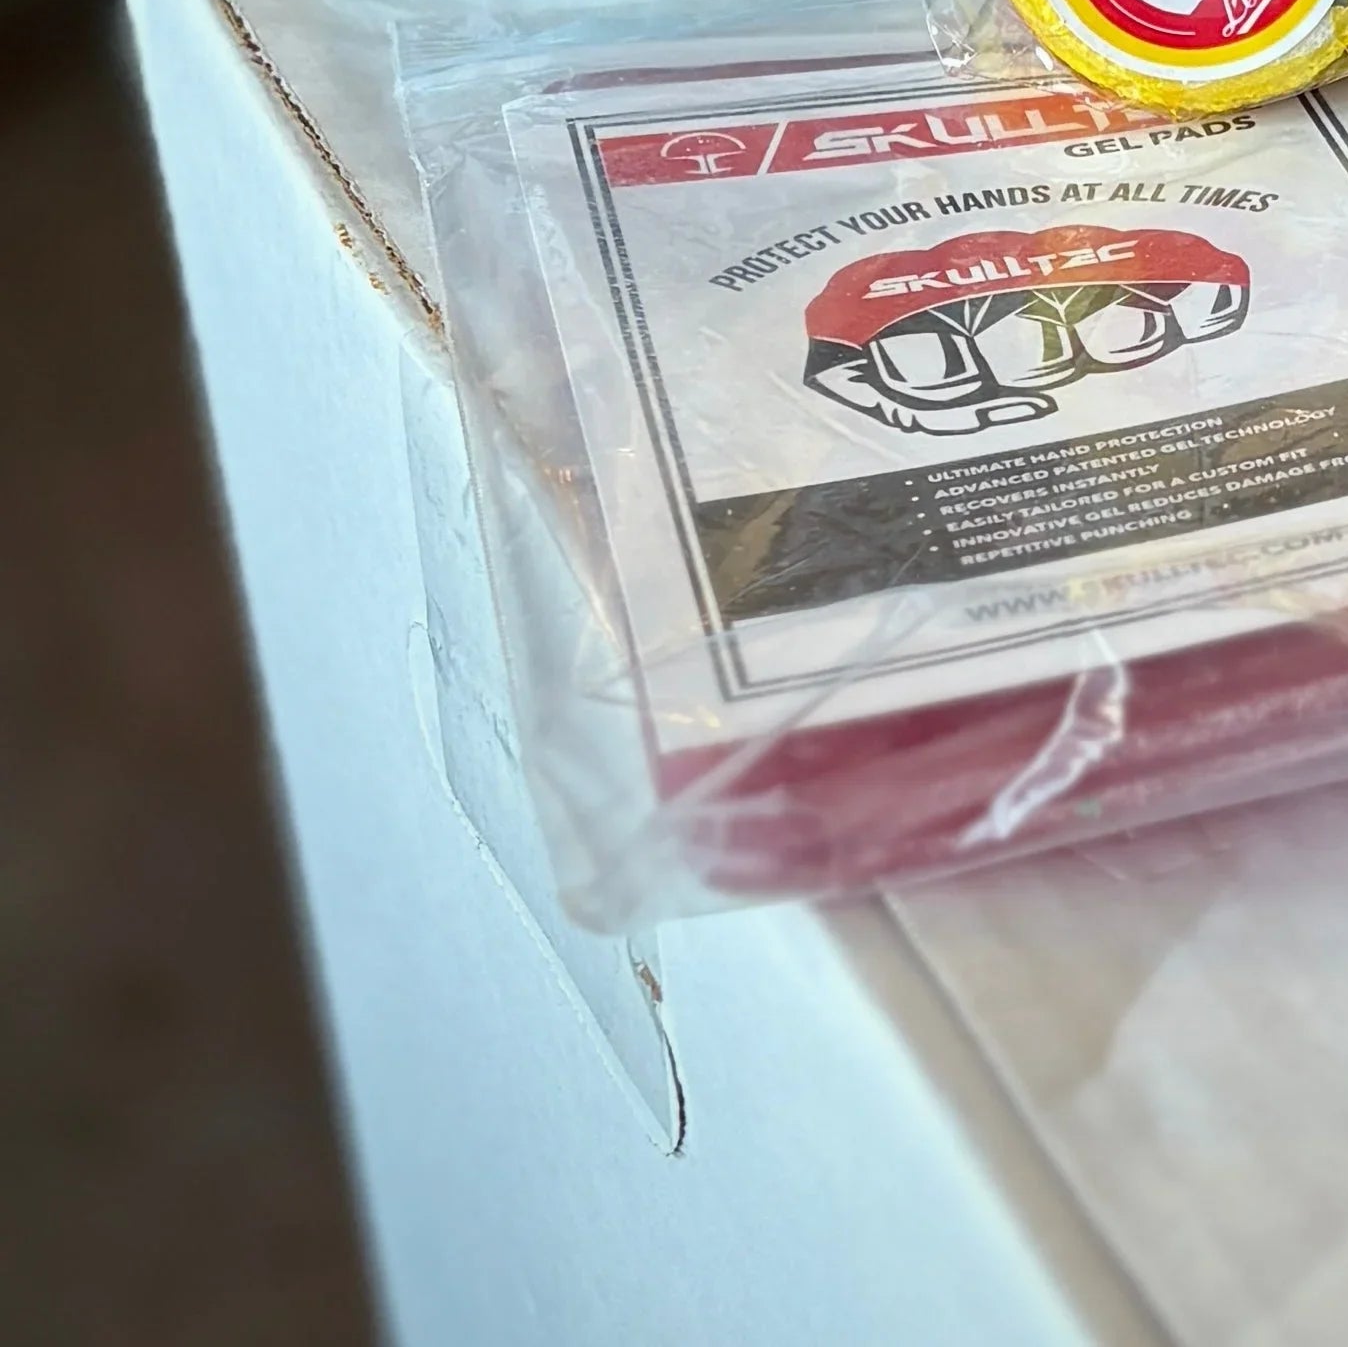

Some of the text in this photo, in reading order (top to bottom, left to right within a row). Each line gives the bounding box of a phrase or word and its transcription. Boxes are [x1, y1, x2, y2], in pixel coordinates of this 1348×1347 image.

[802, 102, 1152, 161] SKULLT
[1063, 115, 1258, 159] GEL PADS
[708, 182, 1281, 293] PROTECT YOUR HANDS AT ALL TIMES
[861, 239, 1140, 301] SKULLTEC
[927, 416, 1224, 483] ULTIMATE HAND PROTECTION
[934, 405, 1337, 500] ADVANCED PATENTED GEL TECHNOLOGY
[939, 463, 1161, 516] RECOVERS INSTANTLY
[946, 447, 1308, 533] EASILY TAILORED FOR A CUSTOM FIT
[952, 514, 1082, 549] INNOVATIVE
[1084, 506, 1126, 523] GEL
[1127, 484, 1223, 513] REDUCES
[1224, 462, 1316, 493] DAMAGE
[959, 509, 1194, 566] REPETITIVE PUNCHING
